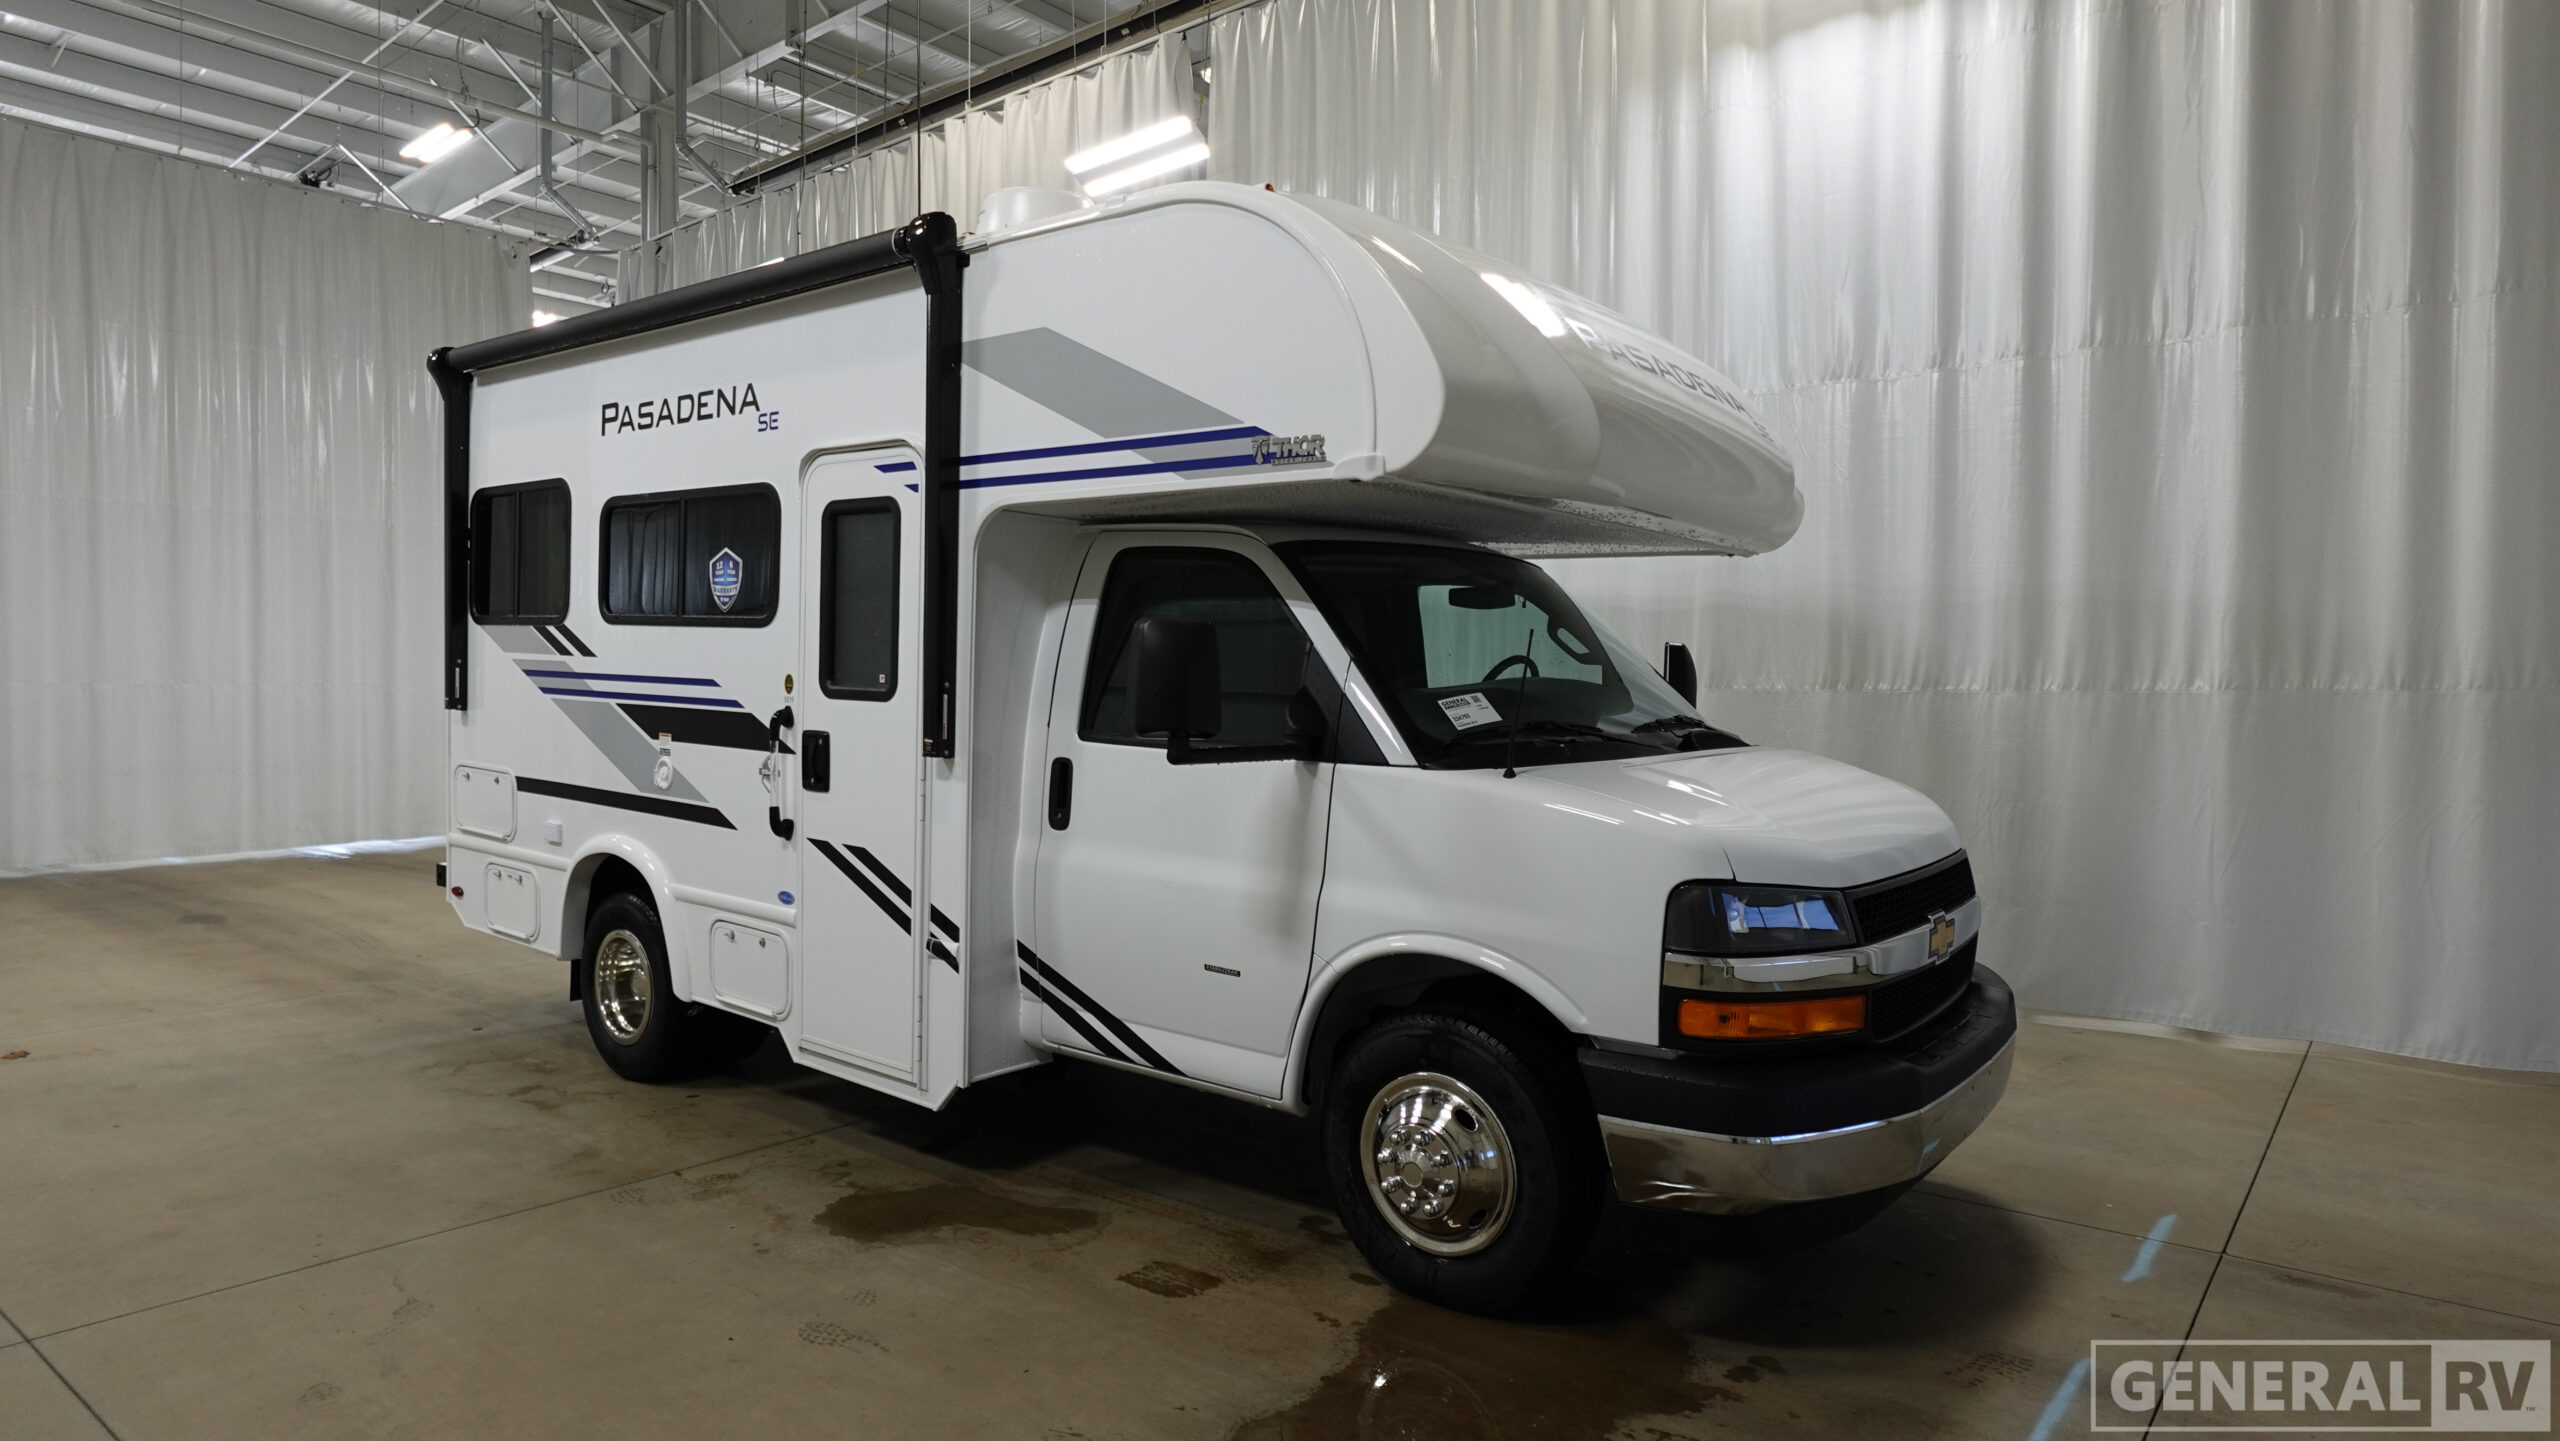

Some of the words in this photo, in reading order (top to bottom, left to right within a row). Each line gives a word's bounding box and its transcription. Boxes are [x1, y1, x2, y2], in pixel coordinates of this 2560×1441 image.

[601, 382, 761, 437] PASADENA
[757, 411, 780, 432] SE
[1271, 434, 1326, 458] THOR
[1441, 697, 1467, 707] GENERAL
